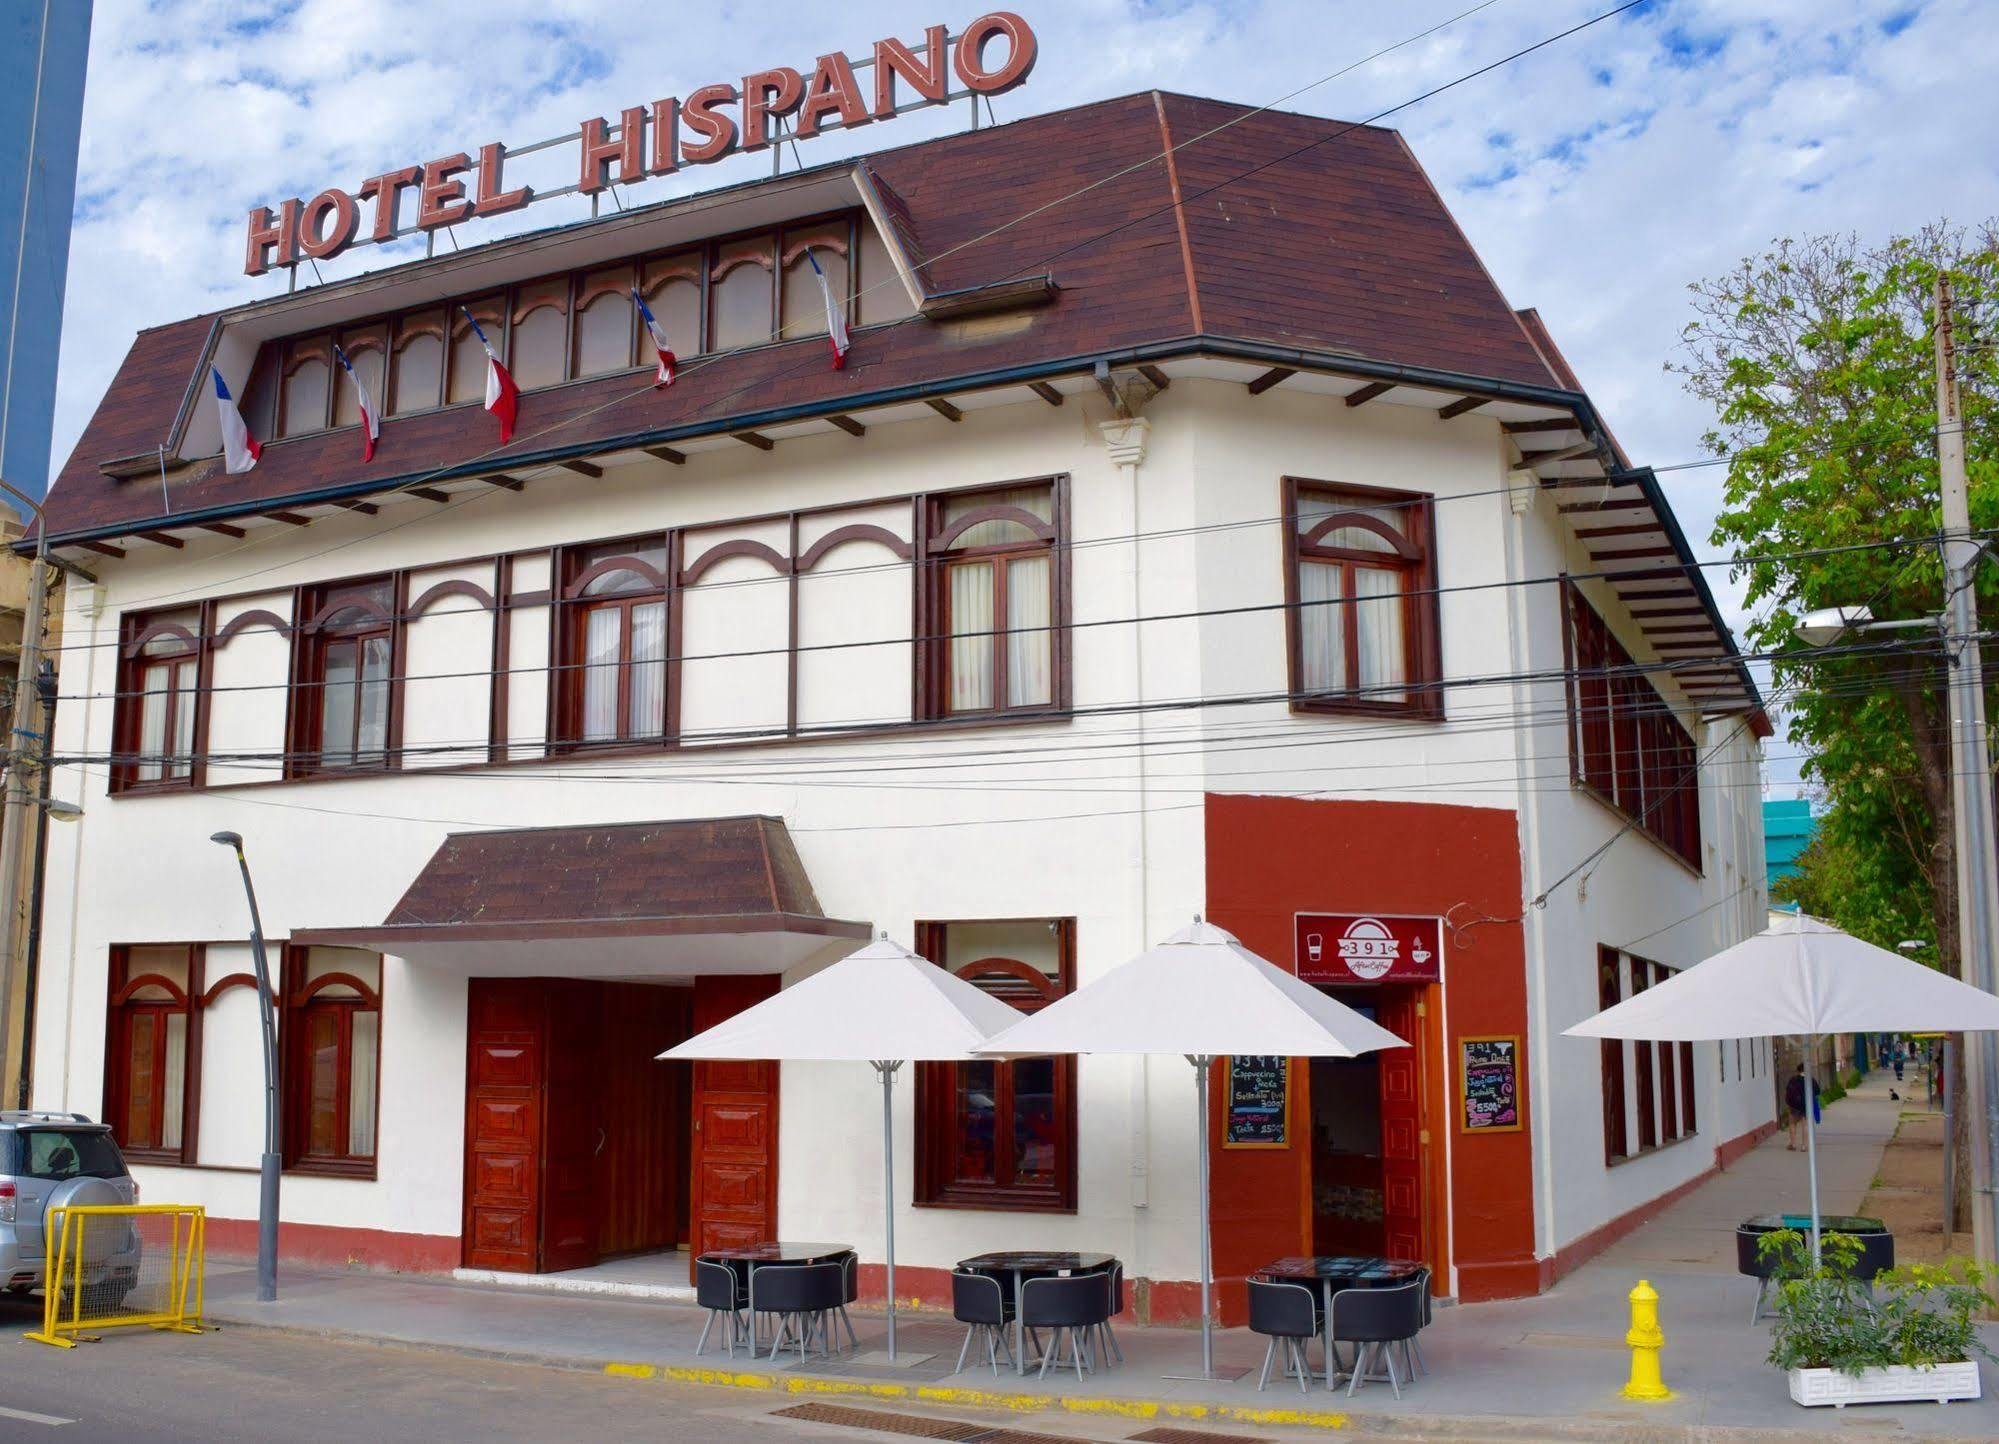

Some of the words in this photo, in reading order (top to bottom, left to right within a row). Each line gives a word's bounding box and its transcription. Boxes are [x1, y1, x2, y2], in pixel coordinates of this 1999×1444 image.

[243, 141, 534, 276] HOTEL
[578, 11, 1039, 194] HISPANO
[1233, 1068, 1276, 1080] Cappuccino
